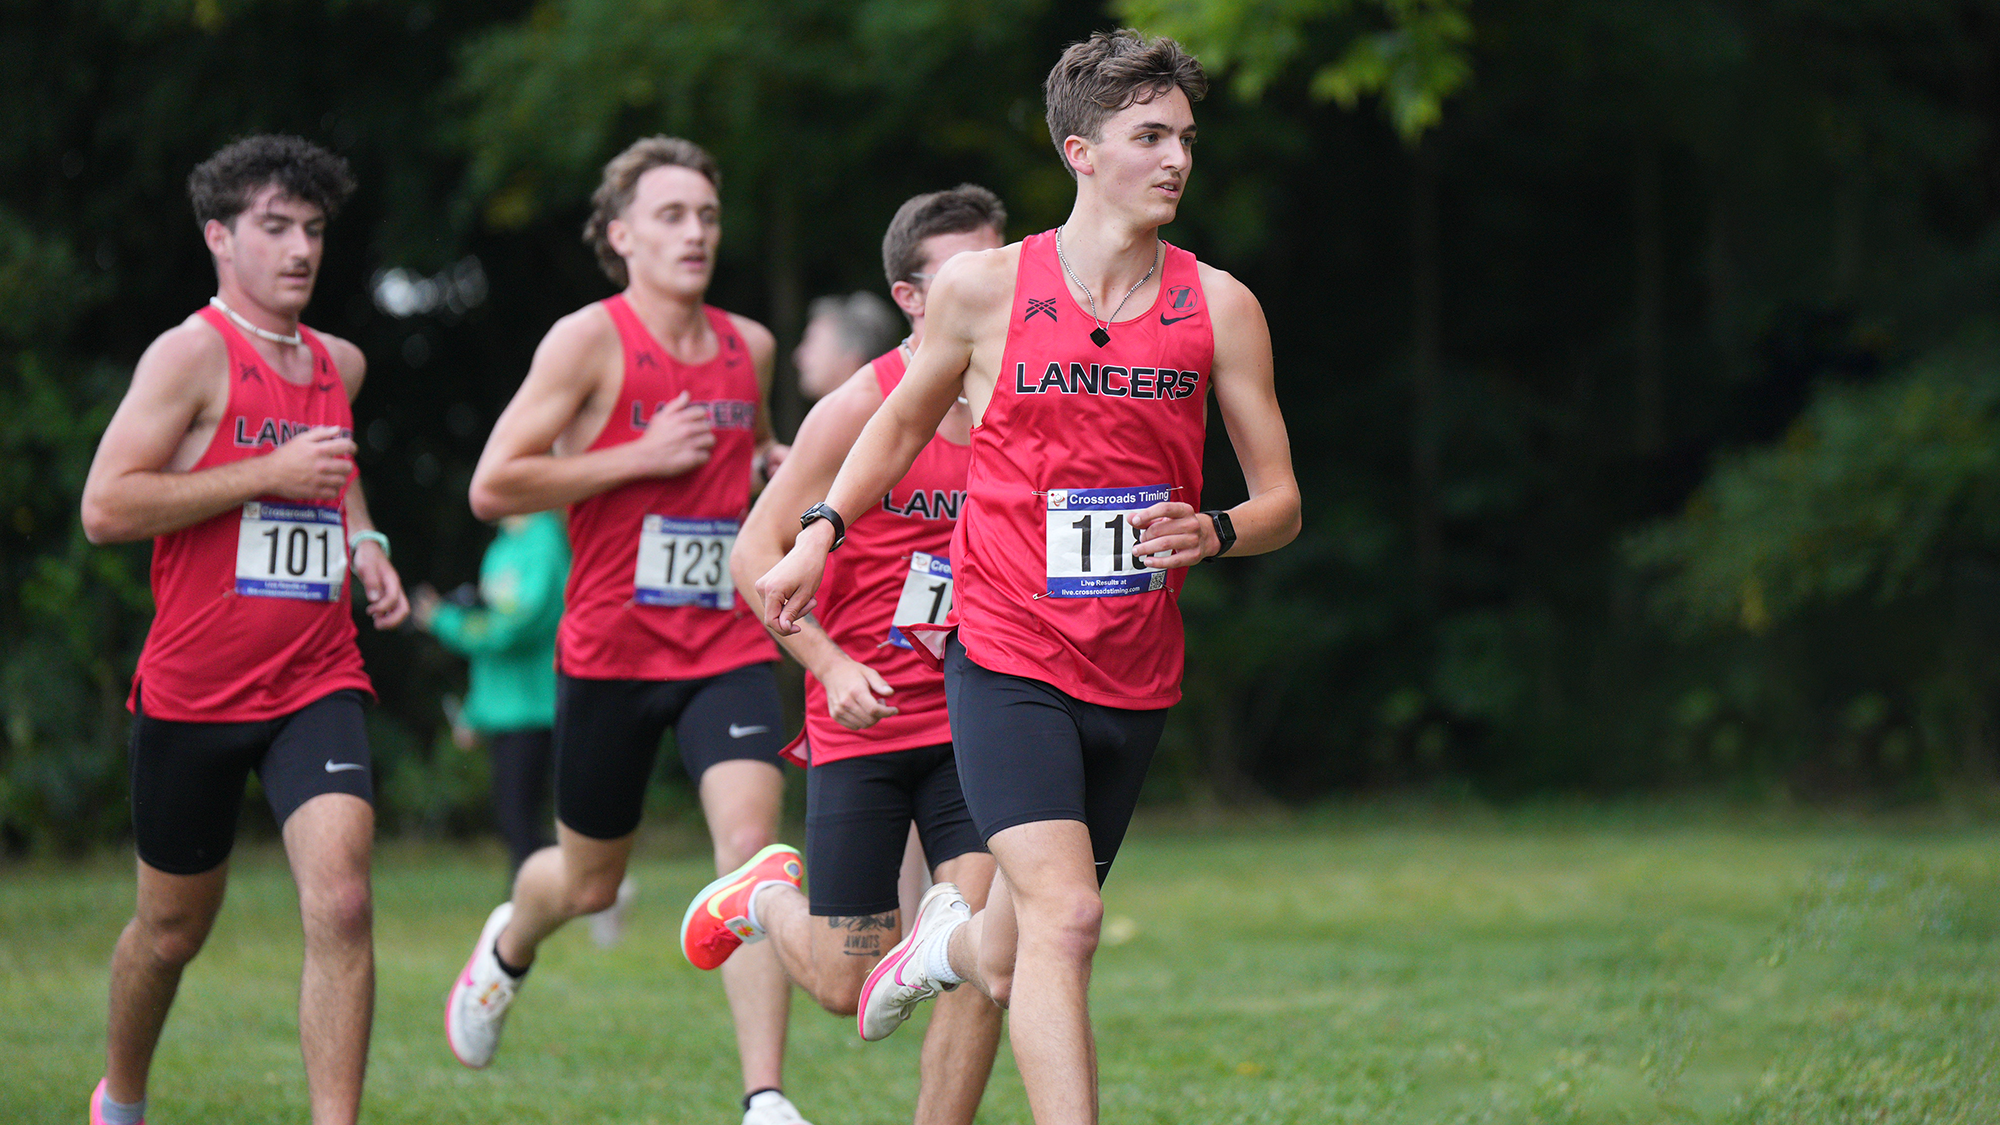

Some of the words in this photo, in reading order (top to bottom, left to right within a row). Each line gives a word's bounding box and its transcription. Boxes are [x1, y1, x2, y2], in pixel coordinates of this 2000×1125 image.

[1015, 362, 1200, 400] LANCERS
[882, 489, 967, 521] LAN
[1069, 493, 1137, 505] Crossroads
[1138, 489, 1169, 502] Timing
[262, 525, 329, 578] 101
[662, 540, 725, 587] 123
[928, 582, 953, 624] 1
[1061, 586, 1141, 596] live.crossroadstiming.com
[844, 934, 880, 949] AWAITS
